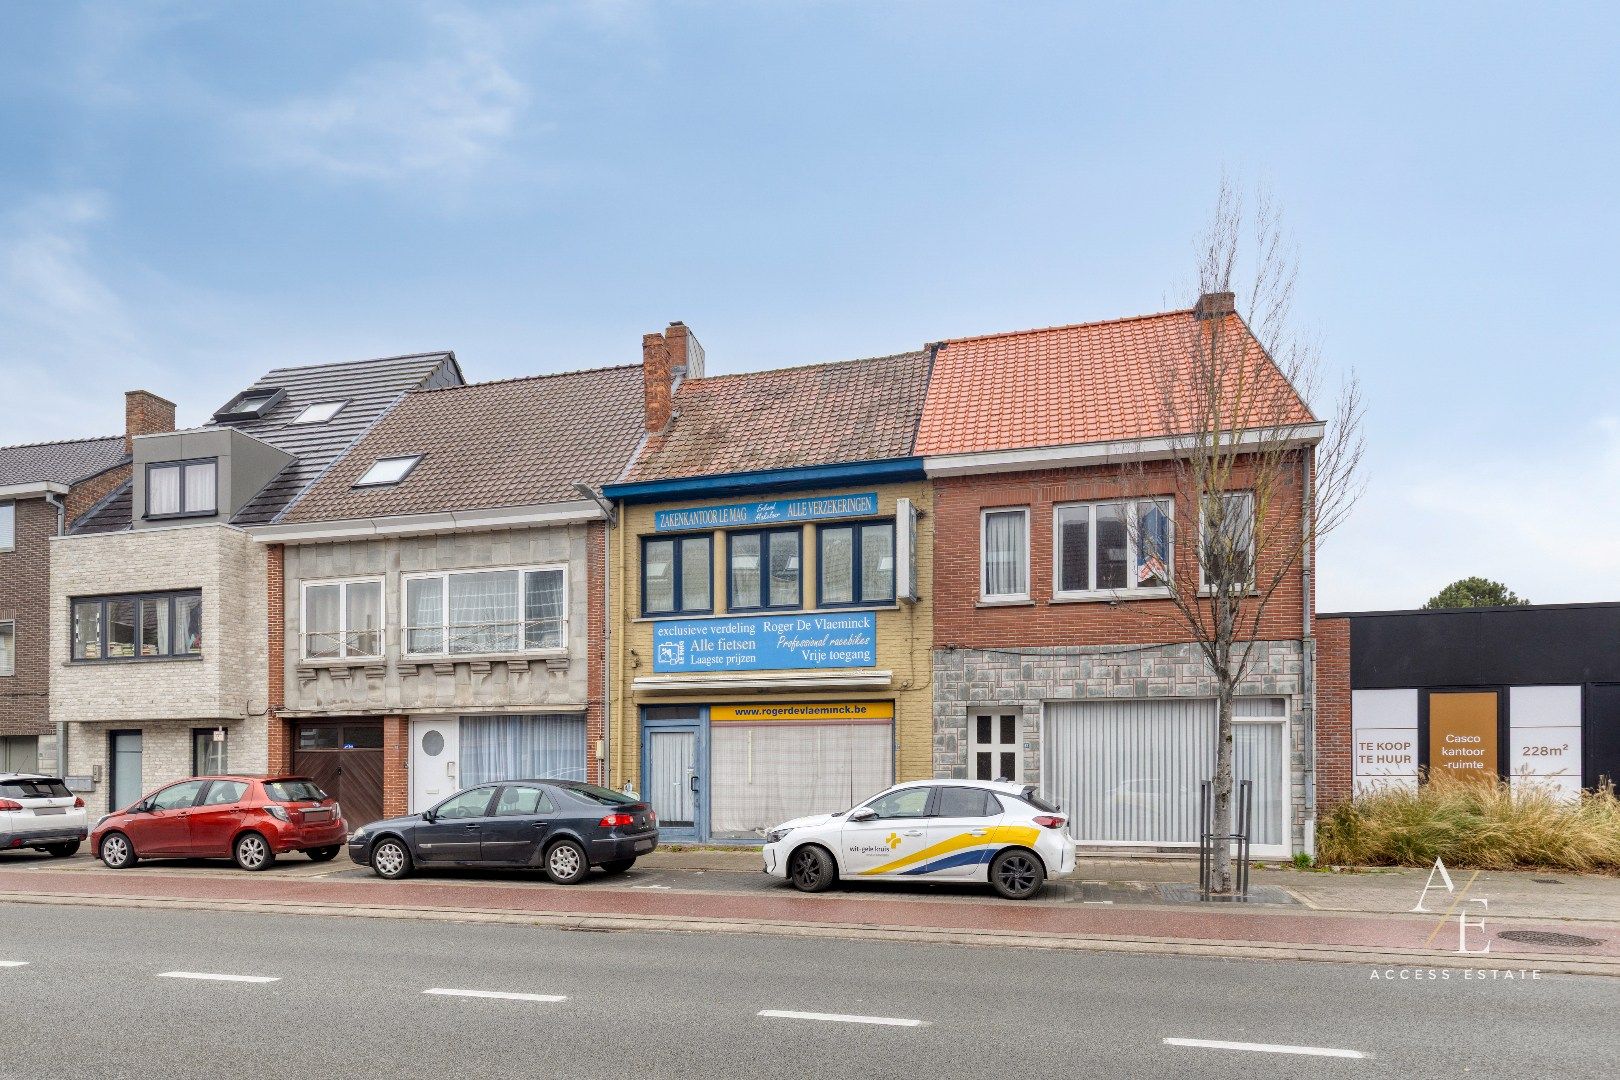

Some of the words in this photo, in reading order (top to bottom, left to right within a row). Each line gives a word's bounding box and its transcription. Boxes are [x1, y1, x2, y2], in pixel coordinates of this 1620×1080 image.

[787, 502, 807, 517] ALLE
[807, 496, 872, 515] VERZEKERINGEN
[660, 509, 718, 528] ZAKENKANTOOR
[719, 508, 729, 523] LE
[729, 507, 747, 522] MAG
[657, 624, 708, 636] exclusieve
[710, 622, 756, 636] verdeling
[763, 621, 794, 635] Roger
[796, 619, 812, 631] De
[814, 616, 871, 630] Vlaeminck
[690, 638, 714, 652] Alle
[717, 637, 756, 651] fietsen
[776, 633, 830, 652] Professional
[829, 632, 871, 647] racebikes
[690, 654, 724, 667] Laagste
[725, 653, 756, 665] prijzen
[801, 649, 827, 663] Vrije
[829, 649, 871, 663] toegang
[734, 705, 867, 717] www.rogerdevlaeminck.be
[1445, 734, 1481, 743] Casco
[1358, 742, 1374, 751] TE
[1376, 742, 1411, 751] KOOP
[1441, 746, 1485, 756] kantoor
[1522, 743, 1569, 756] 228m²
[1358, 755, 1374, 764] TE
[1376, 755, 1412, 764] HUUR
[1443, 759, 1484, 769] -ruimte
